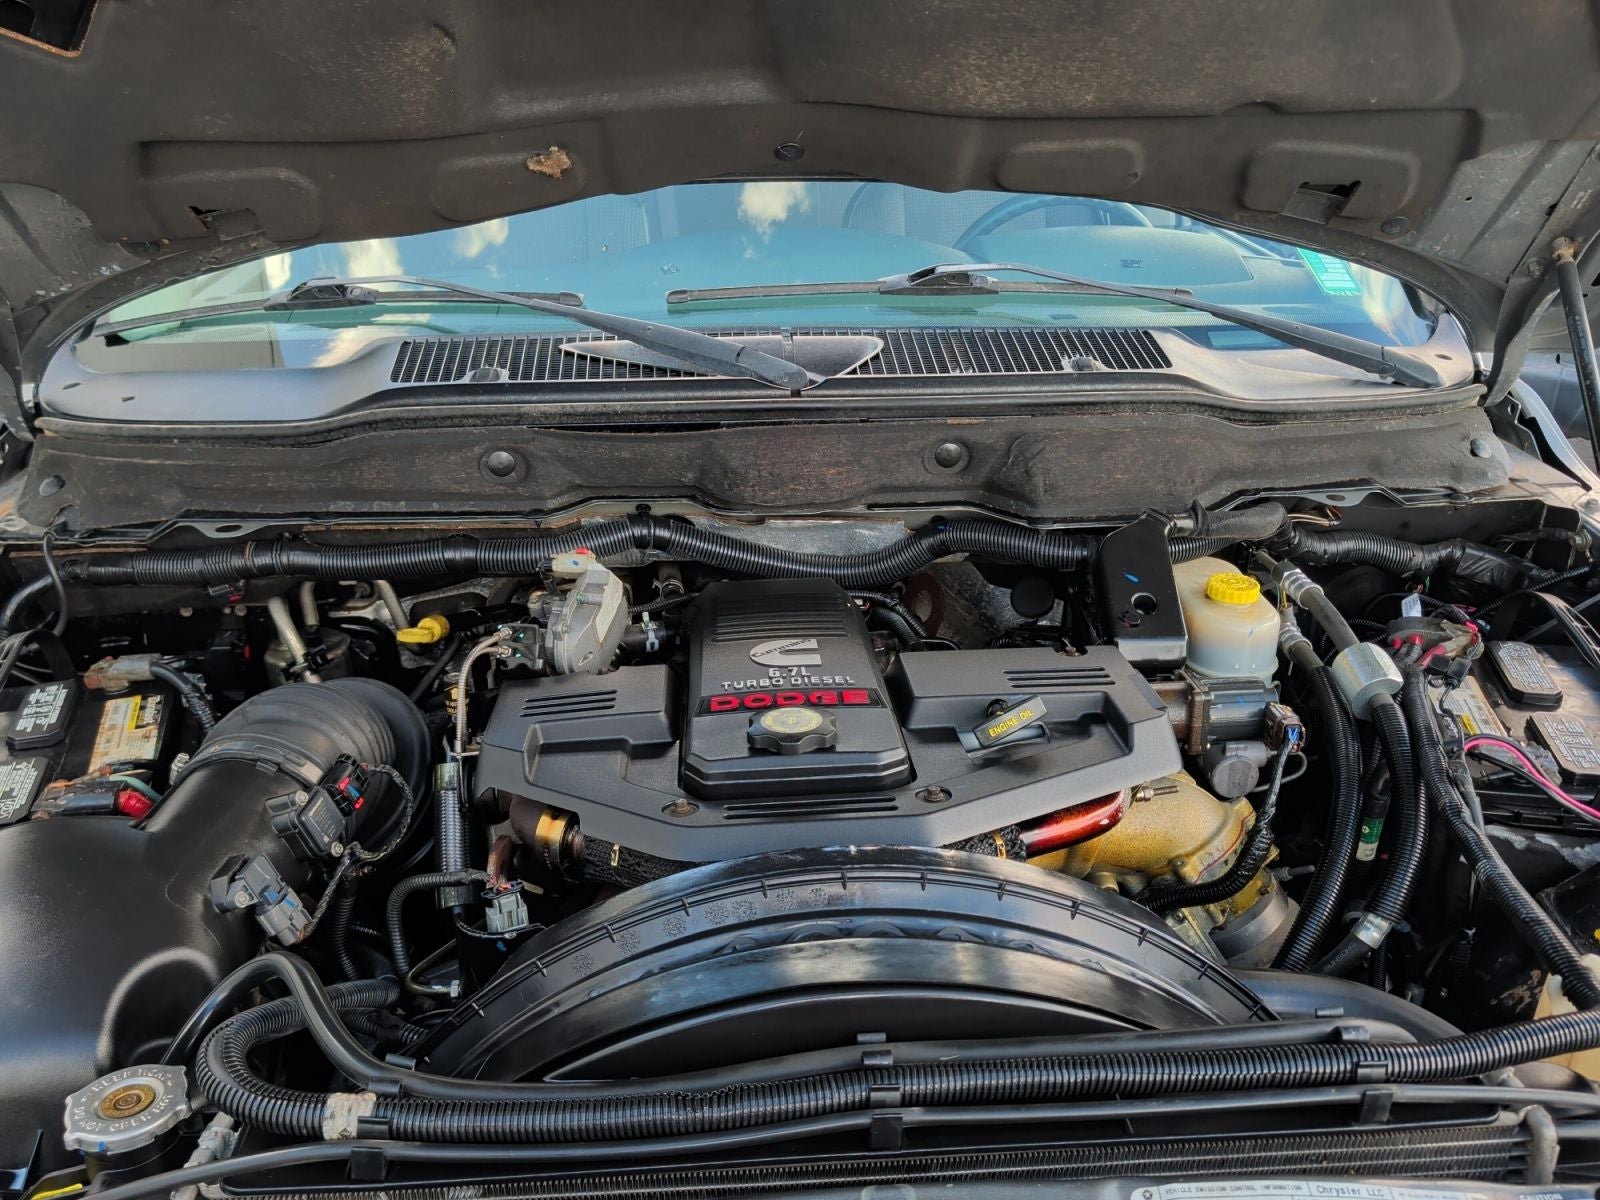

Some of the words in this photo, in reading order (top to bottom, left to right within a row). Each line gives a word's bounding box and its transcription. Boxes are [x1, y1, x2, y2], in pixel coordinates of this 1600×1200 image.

[751, 639, 812, 657] Cummins
[768, 666, 811, 679] 6.7L
[721, 677, 784, 691] TURBO
[791, 675, 855, 687] DIESEL
[709, 689, 870, 711] DODGE
[988, 716, 1018, 737] ENGINE
[1019, 709, 1034, 720] OIL
[1316, 1185, 1361, 1197] Chrysler
[1367, 1188, 1384, 1197] LLC
[1519, 1192, 1563, 1200] CAUTION
